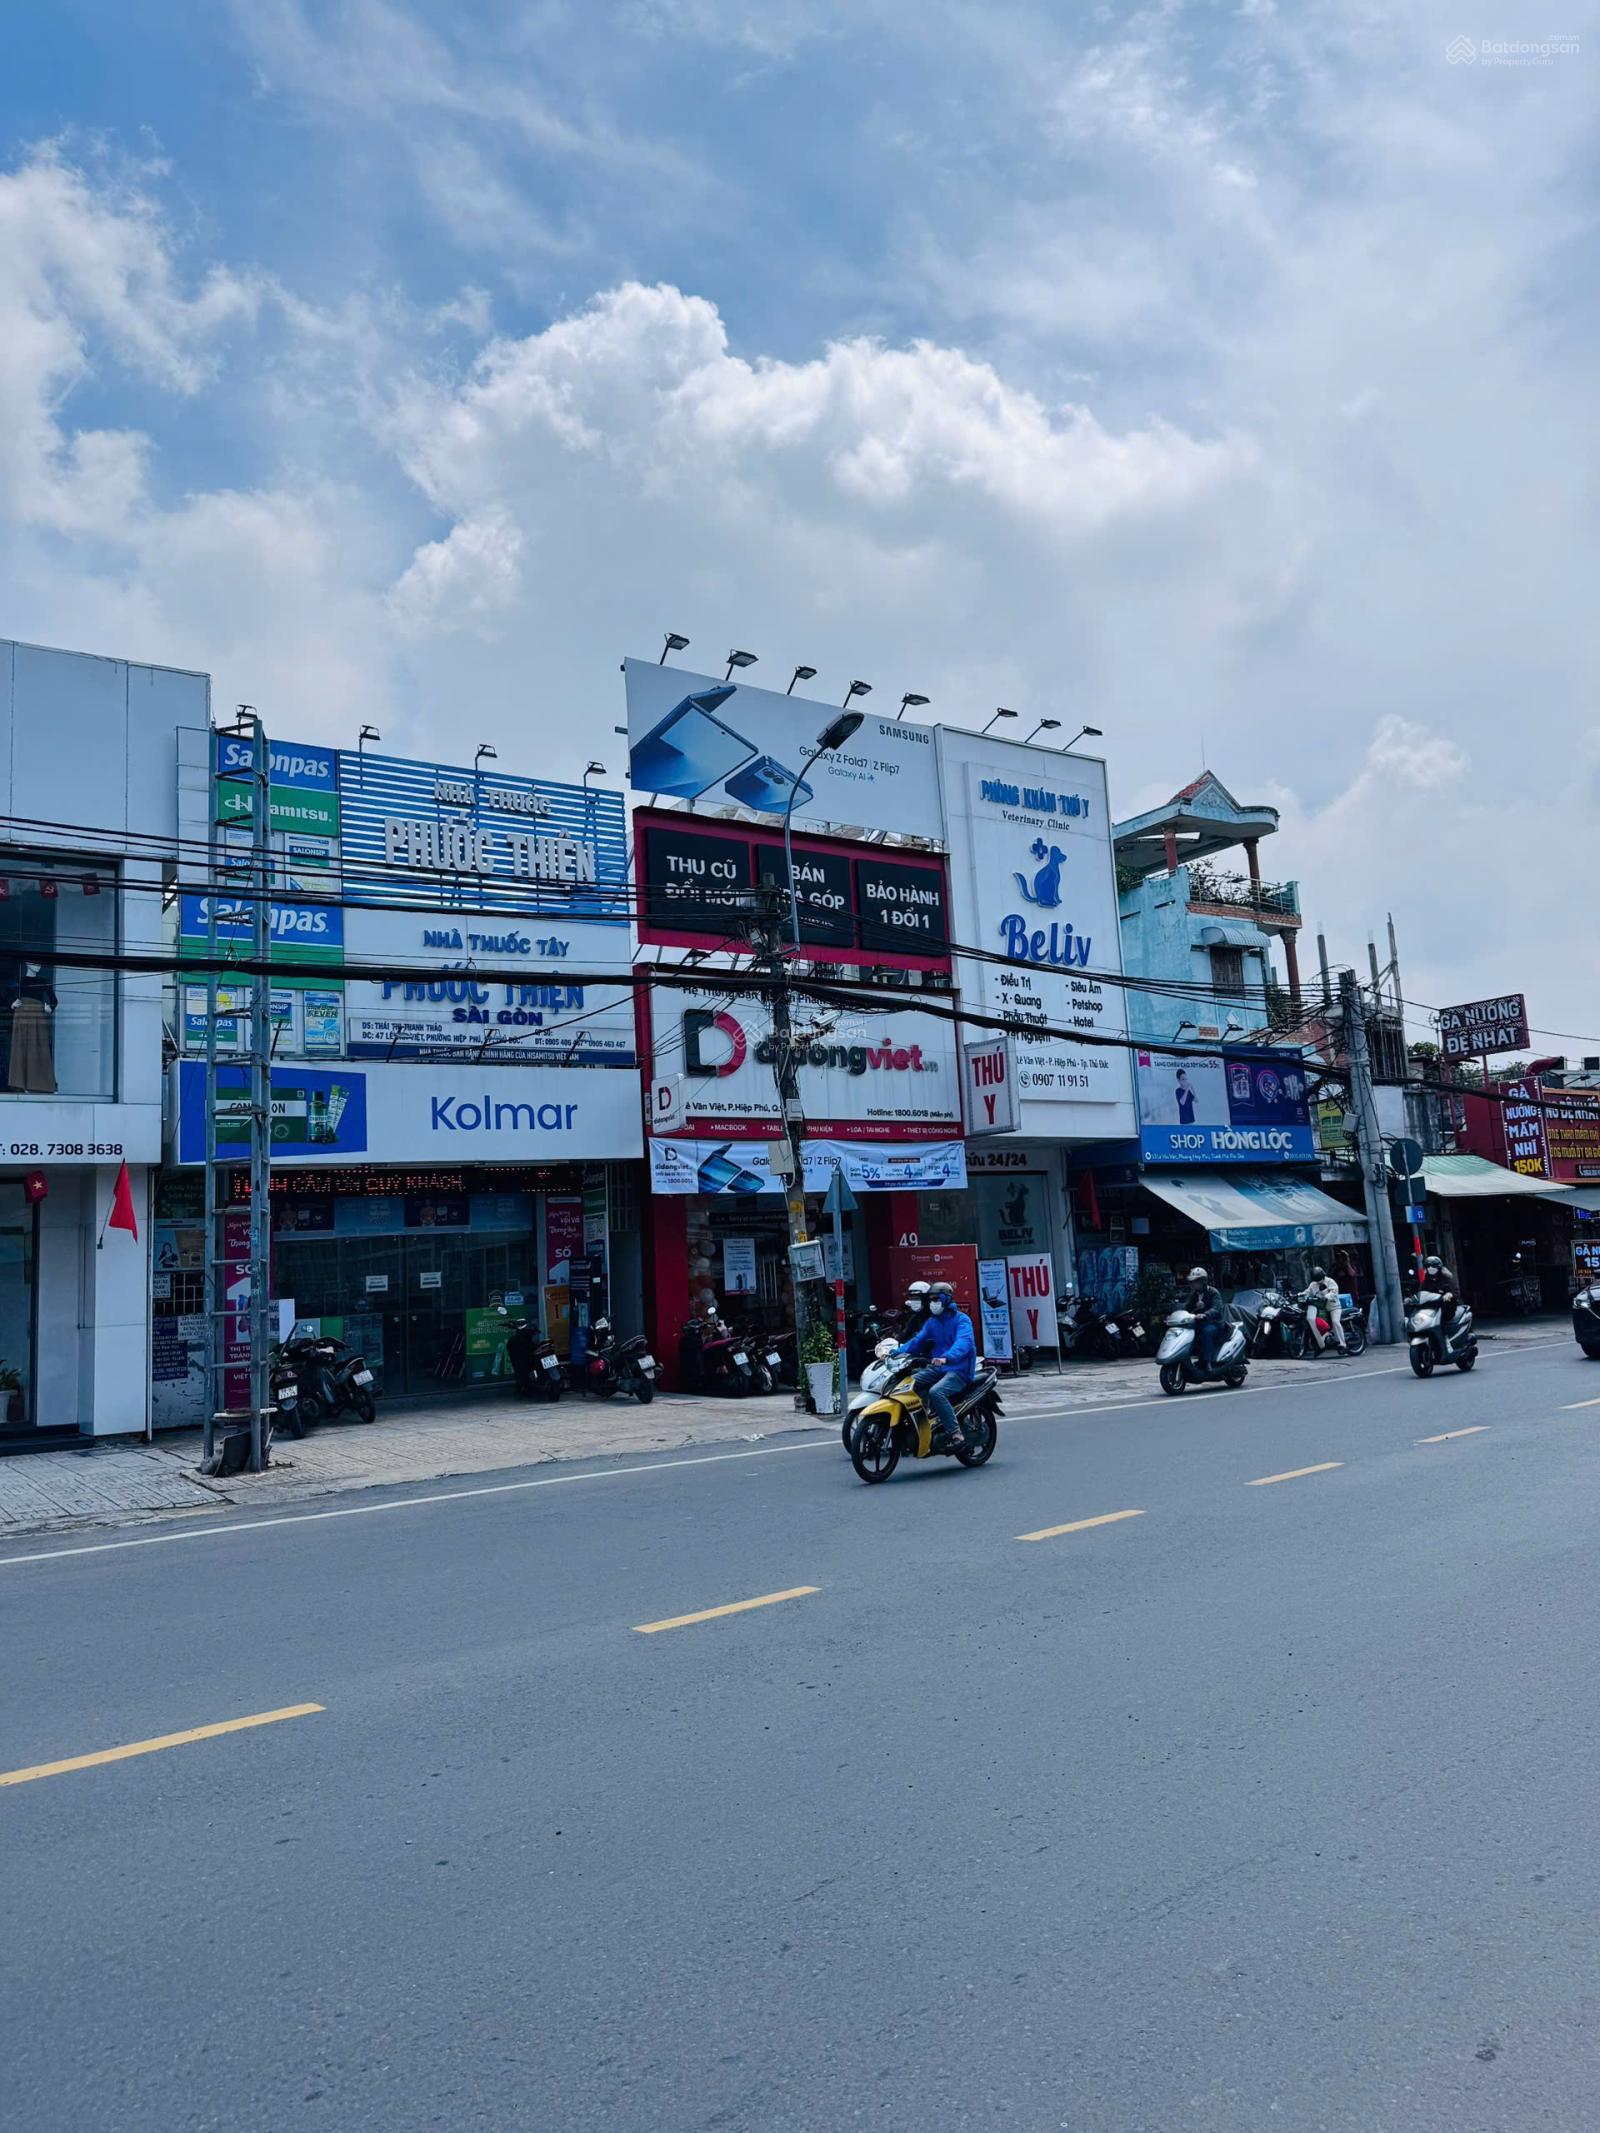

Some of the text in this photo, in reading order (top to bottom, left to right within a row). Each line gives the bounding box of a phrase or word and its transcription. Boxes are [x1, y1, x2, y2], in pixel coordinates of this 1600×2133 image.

[879, 724, 929, 744] SAMSUNG
[828, 766, 857, 780] Galaxy
[836, 753, 842, 763] Z
[843, 755, 868, 768] Fold7
[873, 760, 879, 770] Z
[880, 763, 900, 776] Flip7
[434, 781, 476, 805] NHÀ
[1082, 798, 1090, 819] Y
[1002, 810, 1070, 831] Veterinary Clinic
[384, 811, 596, 889] PHƯỚC THIỆN
[666, 855, 737, 880] THU CŨ
[791, 862, 825, 884] BÁN
[810, 889, 845, 911] GÓP
[866, 880, 940, 906] BẢO HÀNH
[880, 907, 929, 929] 1 ĐỔI 1
[423, 929, 570, 957] NHÀ THUỐC TÂY
[1000, 914, 1091, 967] Beliv
[1000, 972, 1019, 988] Điều
[452, 1006, 543, 1026] SÀI GÒN
[1072, 998, 1103, 1014] Petshop
[1074, 1016, 1094, 1028] Hotel
[972, 1046, 1005, 1087] THÚ
[1032, 1073, 1054, 1086] 0907
[431, 1095, 578, 1131] Kolmar
[867, 1108, 893, 1117] Hotline:
[983, 1094, 996, 1125] Y
[10, 1143, 44, 1156] 028.
[47, 1143, 83, 1156] 7308
[87, 1143, 123, 1156] 3638
[1170, 1125, 1293, 1153] SHOP HỒNG LỘC
[823, 1156, 842, 1167] Flip7
[987, 1152, 1028, 1167] 24/24
[1514, 1158, 1543, 1175] 150K
[861, 1164, 881, 1179] 5%
[898, 1232, 918, 1247] 49
[1575, 1244, 1590, 1255] GÀ
[1009, 1259, 1050, 1297] THÚ
[1026, 1309, 1039, 1340] Y
